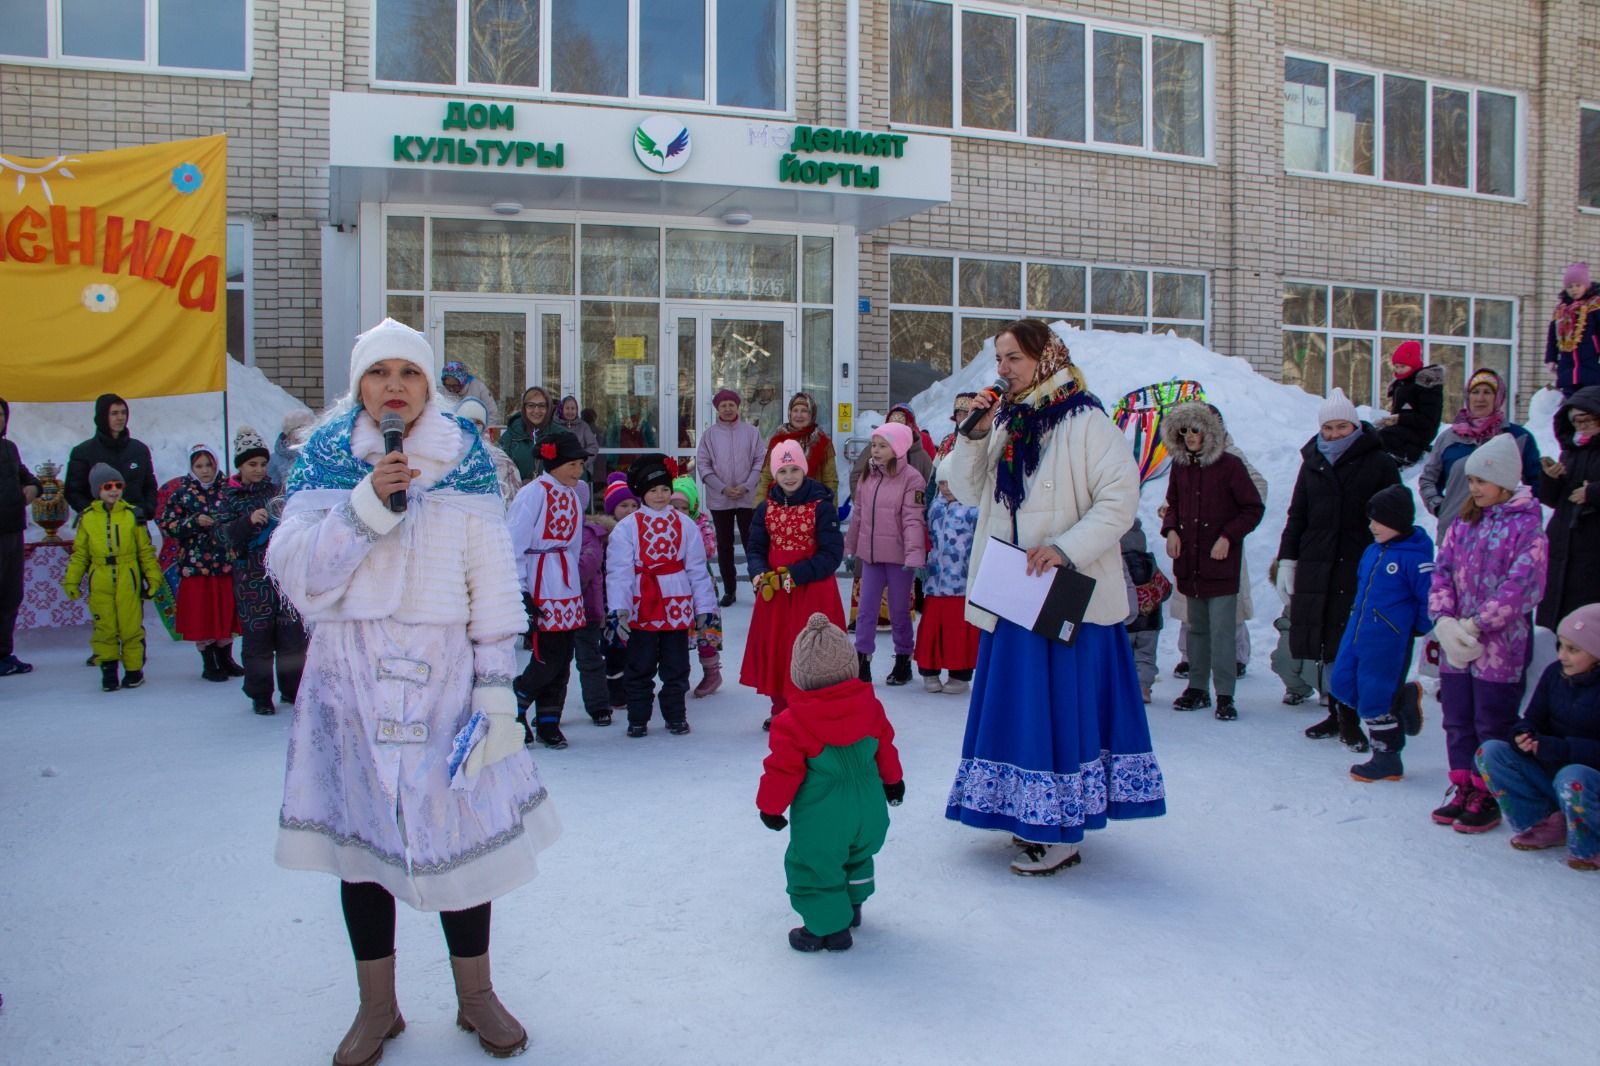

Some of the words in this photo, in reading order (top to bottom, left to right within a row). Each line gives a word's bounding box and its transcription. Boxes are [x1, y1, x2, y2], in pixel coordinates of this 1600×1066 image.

[442, 101, 514, 130] ДОМ
[393, 135, 564, 168] КУЛЬТУРЫ
[779, 153, 880, 189] ЙОРТЫ
